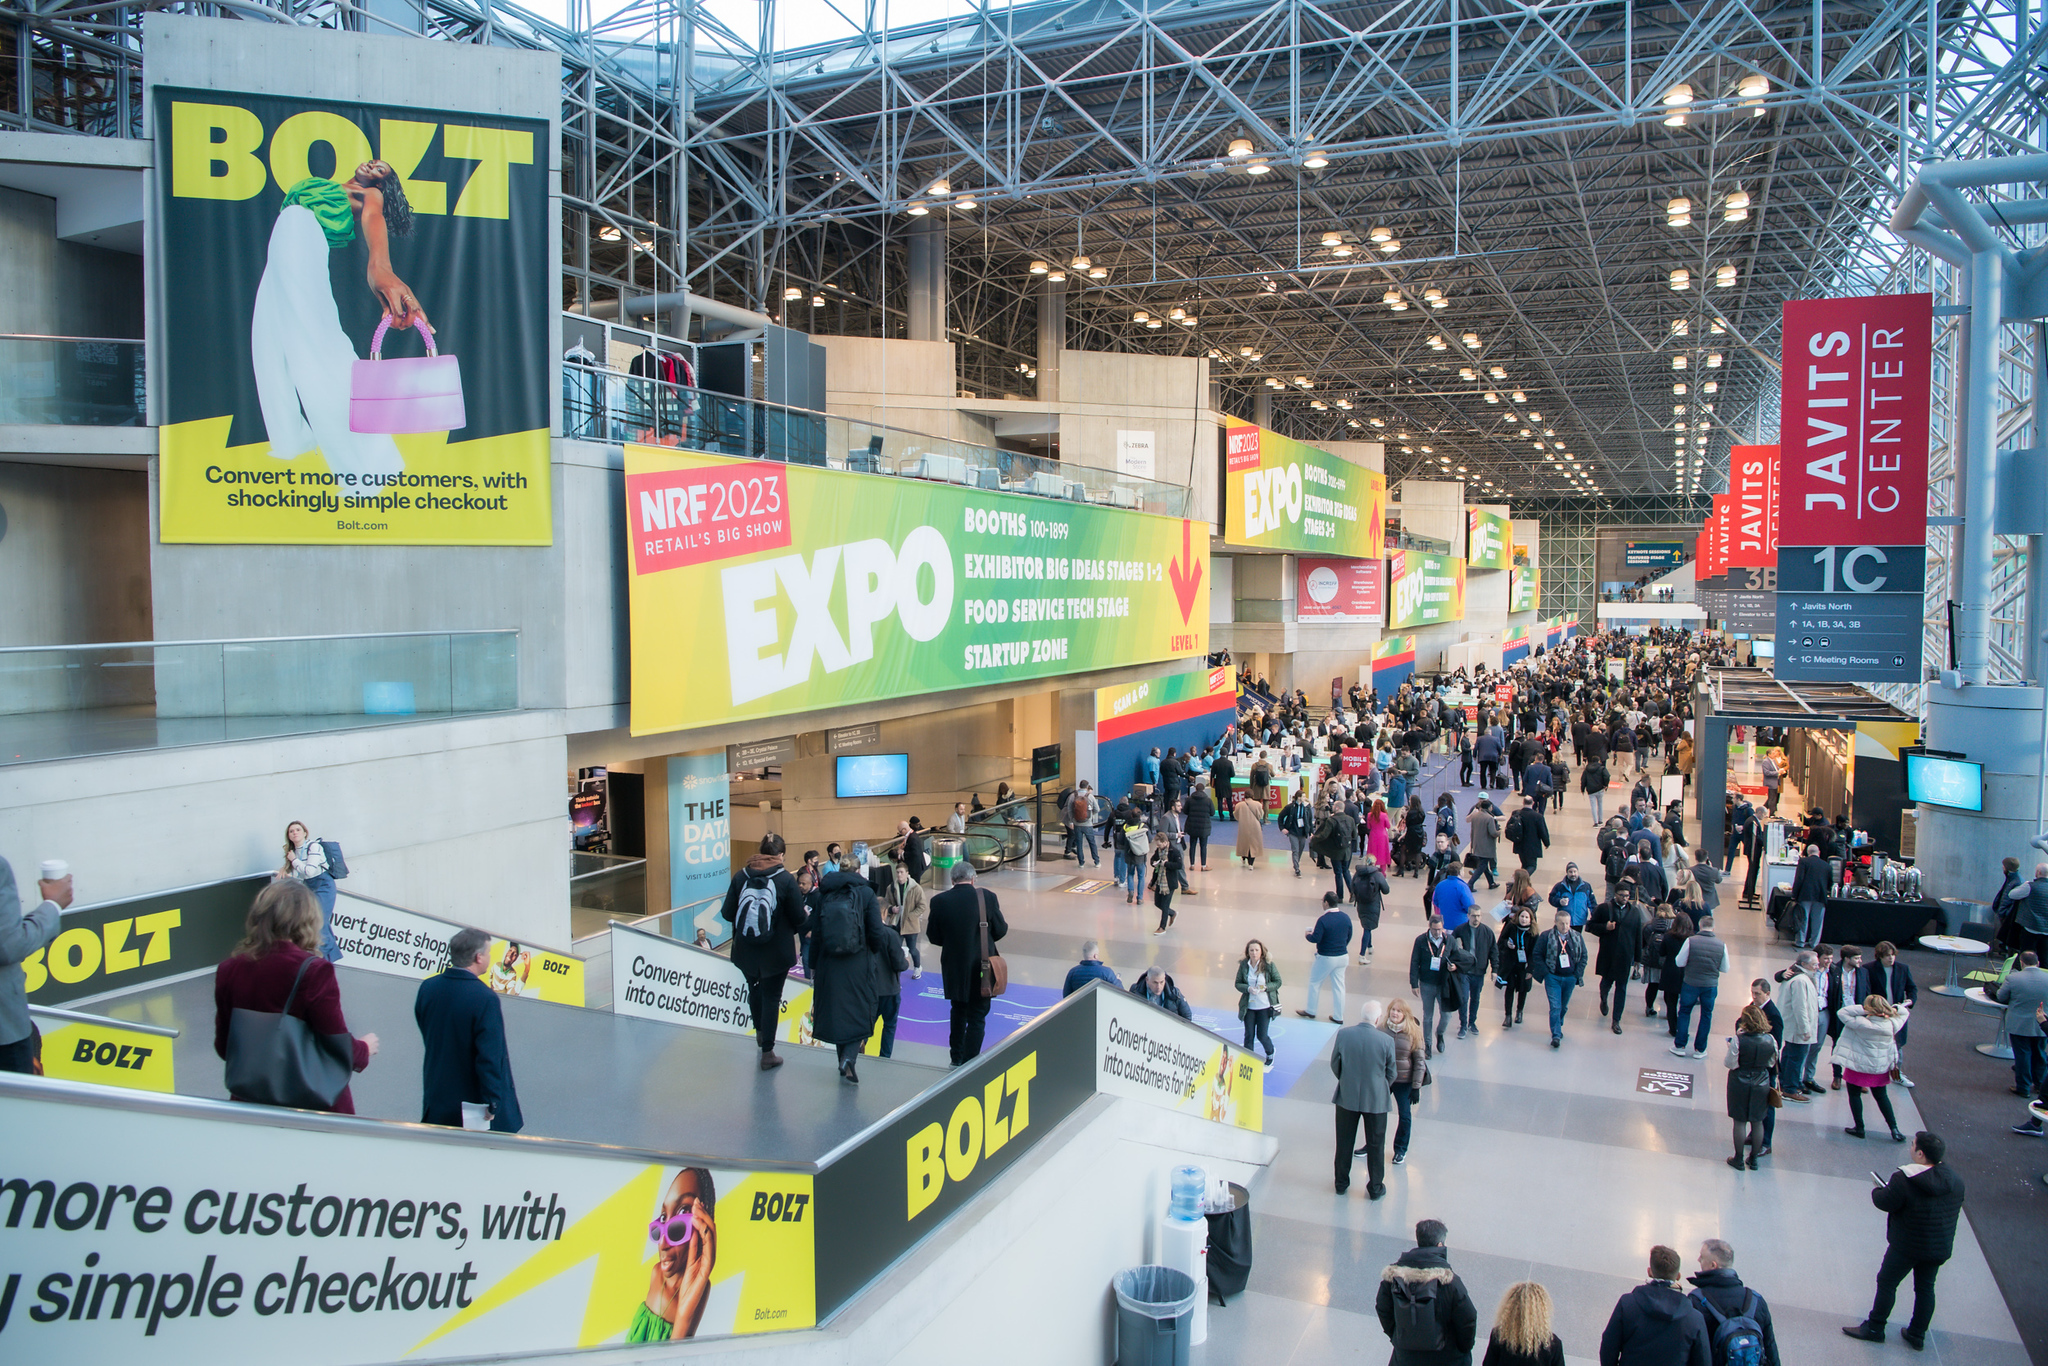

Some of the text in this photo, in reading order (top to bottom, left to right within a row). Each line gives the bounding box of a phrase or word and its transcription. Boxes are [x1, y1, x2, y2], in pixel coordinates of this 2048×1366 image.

[172, 101, 534, 220] BOLT
[1805, 331, 1851, 511] JAVITS
[1867, 327, 1904, 513] CENTER
[205, 465, 528, 492] Convert more customers, with
[1304, 463, 1328, 486] BOOTHS
[227, 489, 508, 514] shockingly simple checkout
[1243, 462, 1302, 539] EXPO
[1740, 461, 1764, 551] JAVITS
[337, 520, 389, 531] Bolt.com
[645, 519, 783, 556] RETAIL'S BIG SHOW
[964, 507, 1069, 540] BOOTHS 100-1899
[1304, 517, 1325, 537] STAGES
[964, 553, 1163, 582] EXHIBITOR BIG IDEAS STAGES 1-2
[1744, 567, 1777, 590] 3B
[1813, 546, 1888, 593] 1C
[964, 597, 1129, 625] FOOD SERVICE TECH STAGE
[1397, 566, 1424, 624] EXPO
[1801, 602, 1852, 611] Javits North
[721, 526, 955, 707] EXPO
[1801, 620, 1861, 629] 1A, 1B, 3A, 3B
[964, 637, 1068, 670] STARTUP ZONE
[1171, 633, 1199, 652] LEVEL 1
[1813, 656, 1847, 665] Meeting
[1849, 656, 1880, 665] Rooms
[1113, 682, 1149, 715] SCAN & GO
[1343, 755, 1368, 763] MOBILE
[684, 799, 724, 821] THE
[684, 818, 730, 844] DATA
[684, 837, 730, 865] CLOU
[685, 873, 703, 881] VISIT
[703, 871, 712, 879] US
[329, 912, 451, 962] vert guest shopp
[334, 935, 411, 967] ustomers
[412, 951, 436, 971] for
[542, 958, 571, 976] BOLT
[632, 955, 693, 990] Convert
[693, 975, 732, 999] guest
[625, 980, 655, 1007] into
[657, 993, 730, 1025] customers
[732, 1005, 752, 1028] for
[72, 1038, 153, 1071] BOLT
[1108, 1017, 1206, 1076] Convert guest shoppers
[1103, 1047, 1196, 1100] into customers for life
[1238, 1063, 1254, 1082] BOLT
[907, 1050, 1037, 1222] BOLT
[0, 1178, 566, 1248] more customers, with
[749, 1191, 810, 1223] BOLT
[29, 1252, 244, 1337] simple
[253, 1255, 478, 1316] checkout
[754, 1307, 788, 1321] Bolt.com
